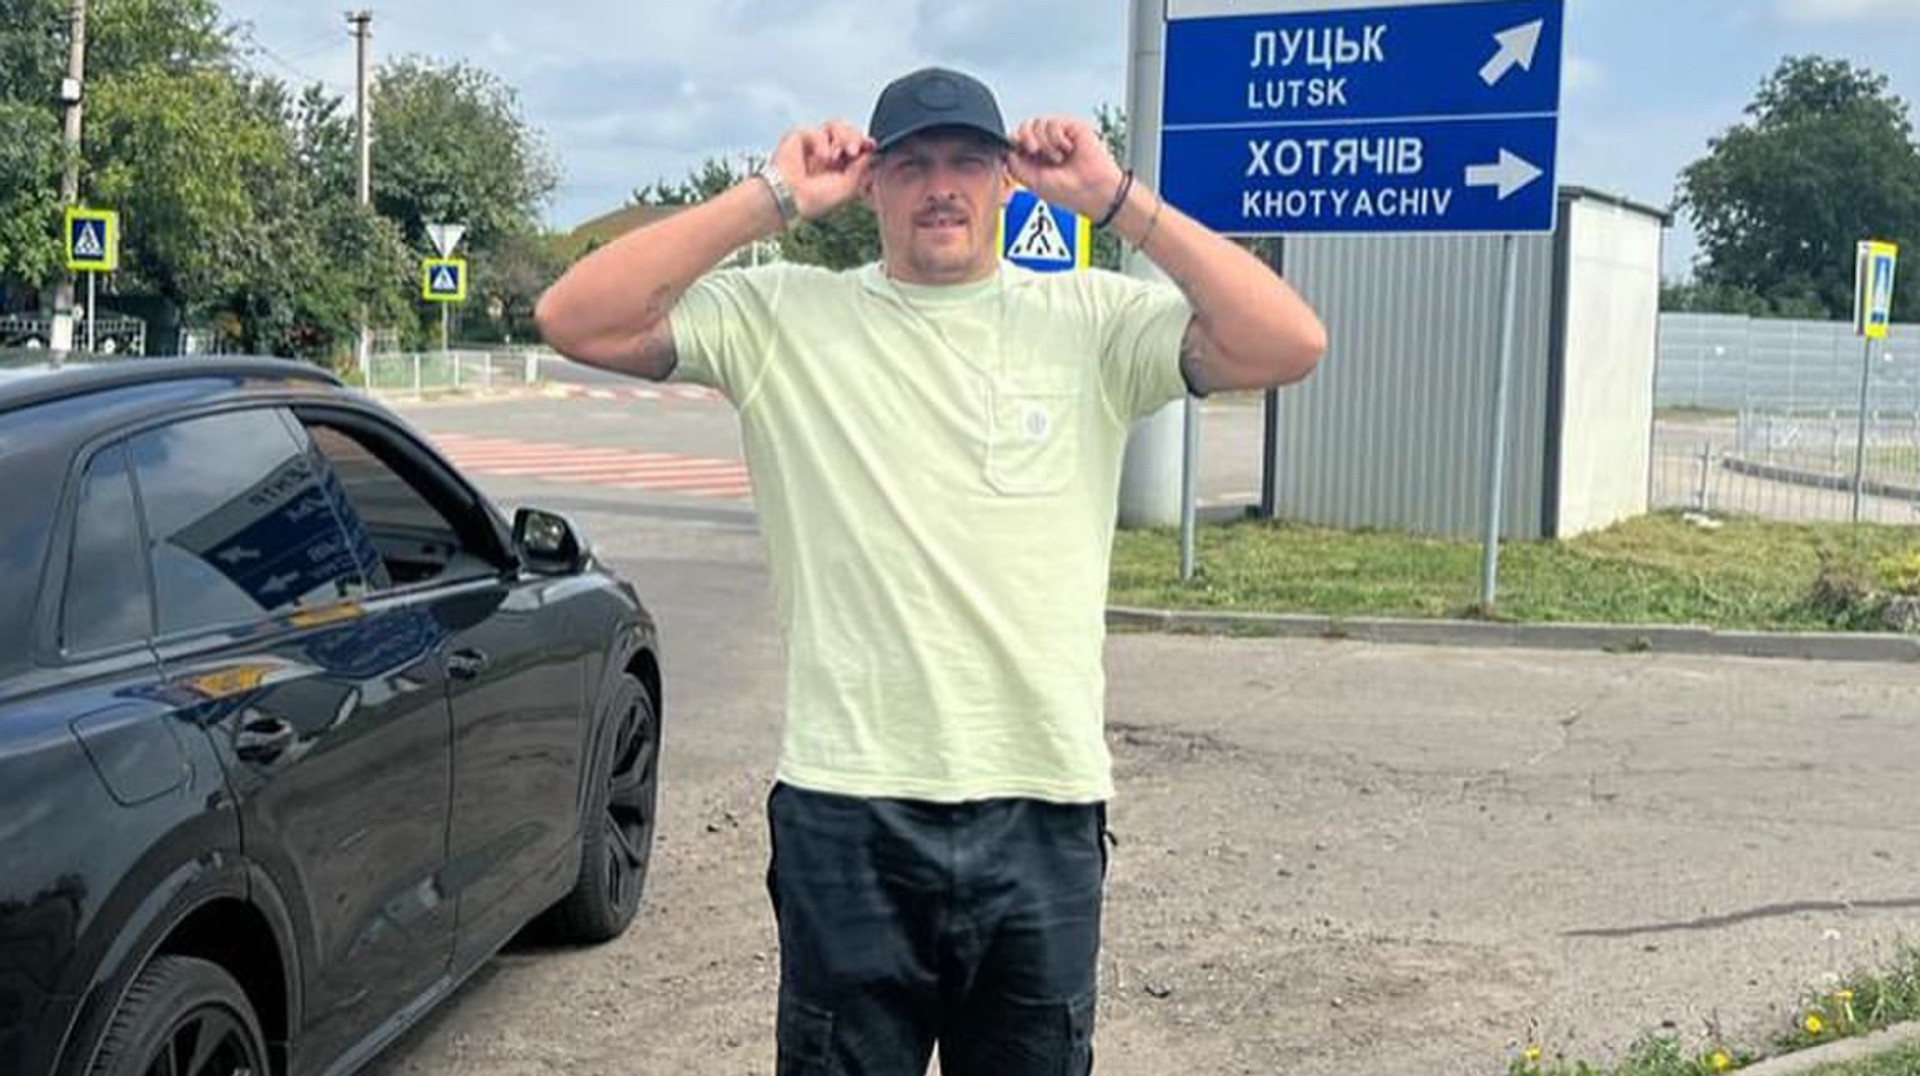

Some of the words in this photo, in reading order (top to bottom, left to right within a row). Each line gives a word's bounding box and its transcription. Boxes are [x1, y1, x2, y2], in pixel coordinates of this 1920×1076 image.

[1250, 24, 1387, 71] ЛУЦЬК
[1247, 78, 1347, 109] LUTSK
[1246, 136, 1423, 177] ХОТЯЧІВ
[1242, 188, 1452, 218] KHOTYACHIV
